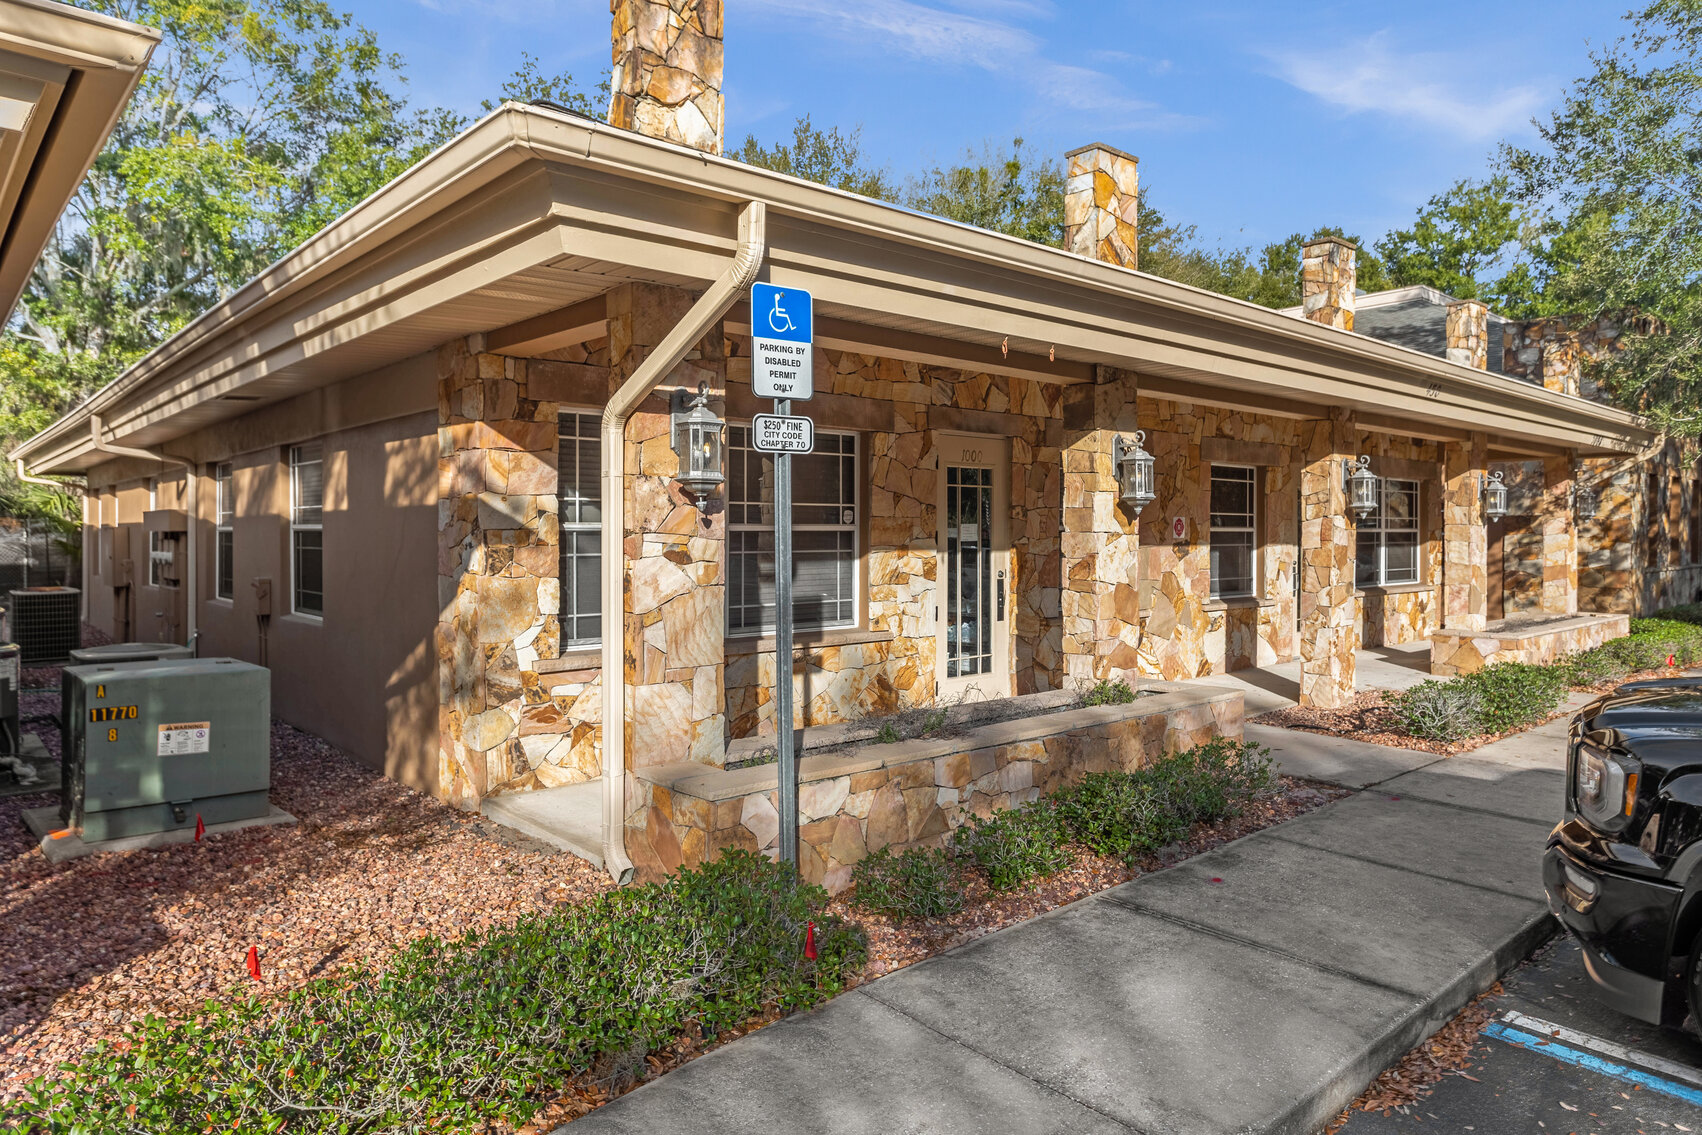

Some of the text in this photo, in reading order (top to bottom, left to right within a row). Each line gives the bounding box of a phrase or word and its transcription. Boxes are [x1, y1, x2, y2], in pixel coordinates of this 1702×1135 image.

[760, 343, 805, 355] PARKING BY
[764, 356, 801, 367] DISABLED
[769, 370, 797, 380] PERMIT
[773, 383, 794, 392] ONLY
[763, 420, 803, 431] $250 FINE
[764, 430, 802, 440] CITY CODE
[761, 439, 806, 449] CHAPTER 70
[961, 449, 983, 462] 1000
[96, 684, 105, 698] A
[91, 705, 137, 722] 11770
[108, 728, 117, 742] 8
